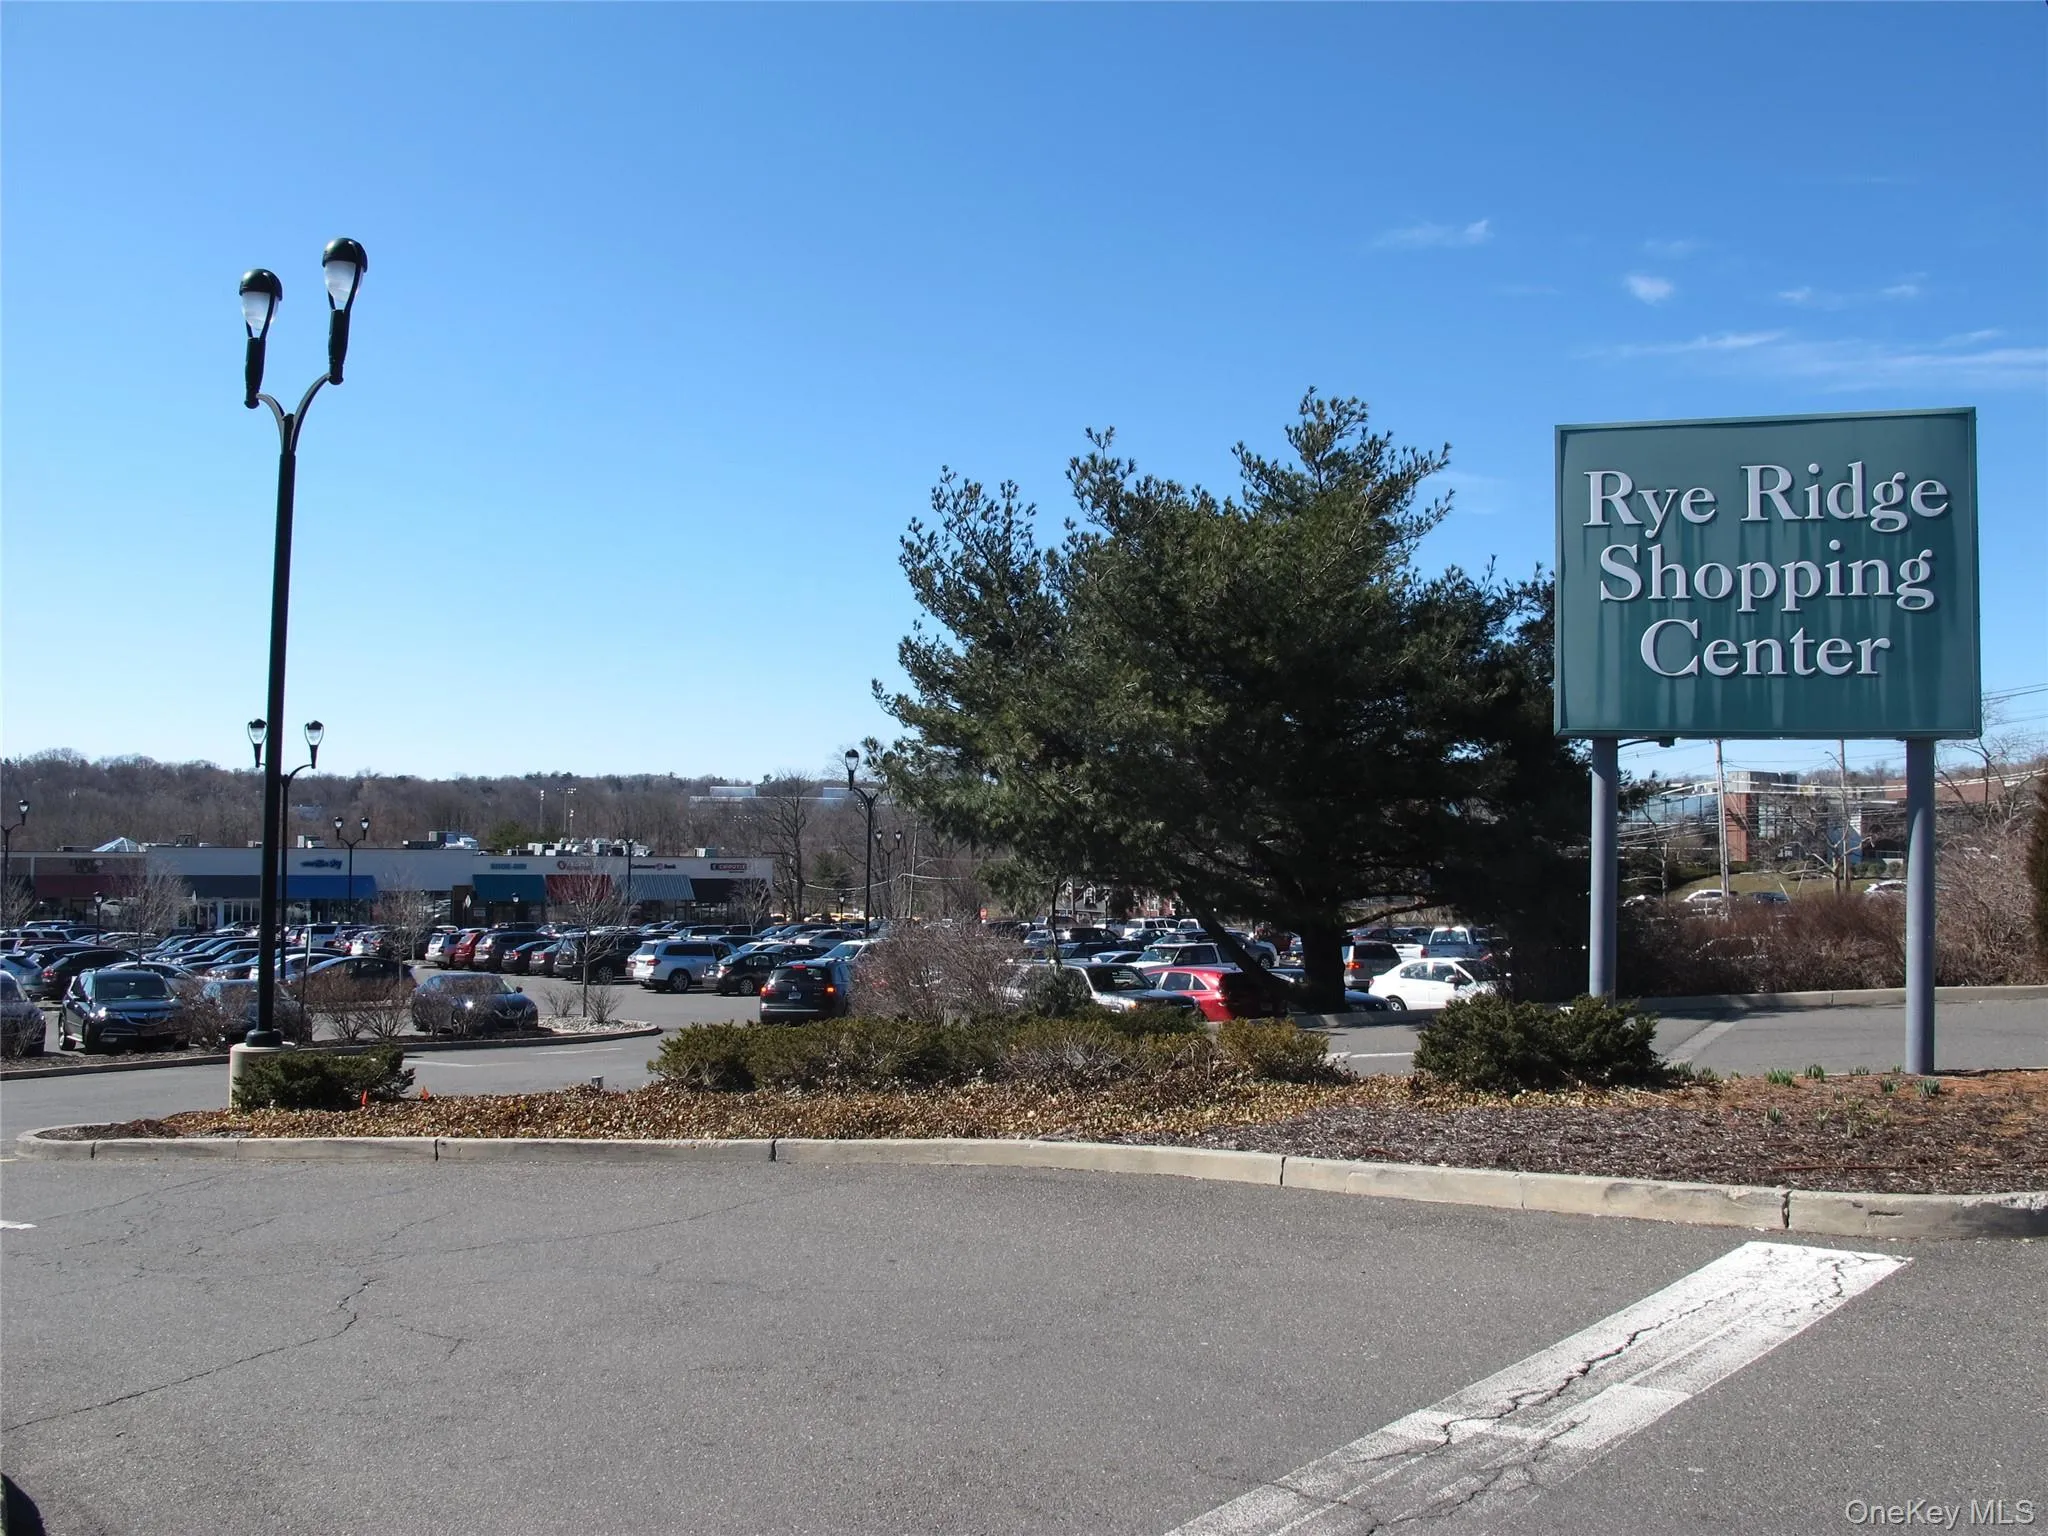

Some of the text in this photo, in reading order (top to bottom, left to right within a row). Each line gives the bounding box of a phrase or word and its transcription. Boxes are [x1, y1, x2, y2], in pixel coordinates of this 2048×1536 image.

[1583, 460, 1950, 539] Rye Ridge
[1600, 539, 1937, 612] Shopping
[1640, 618, 1891, 678] Center
